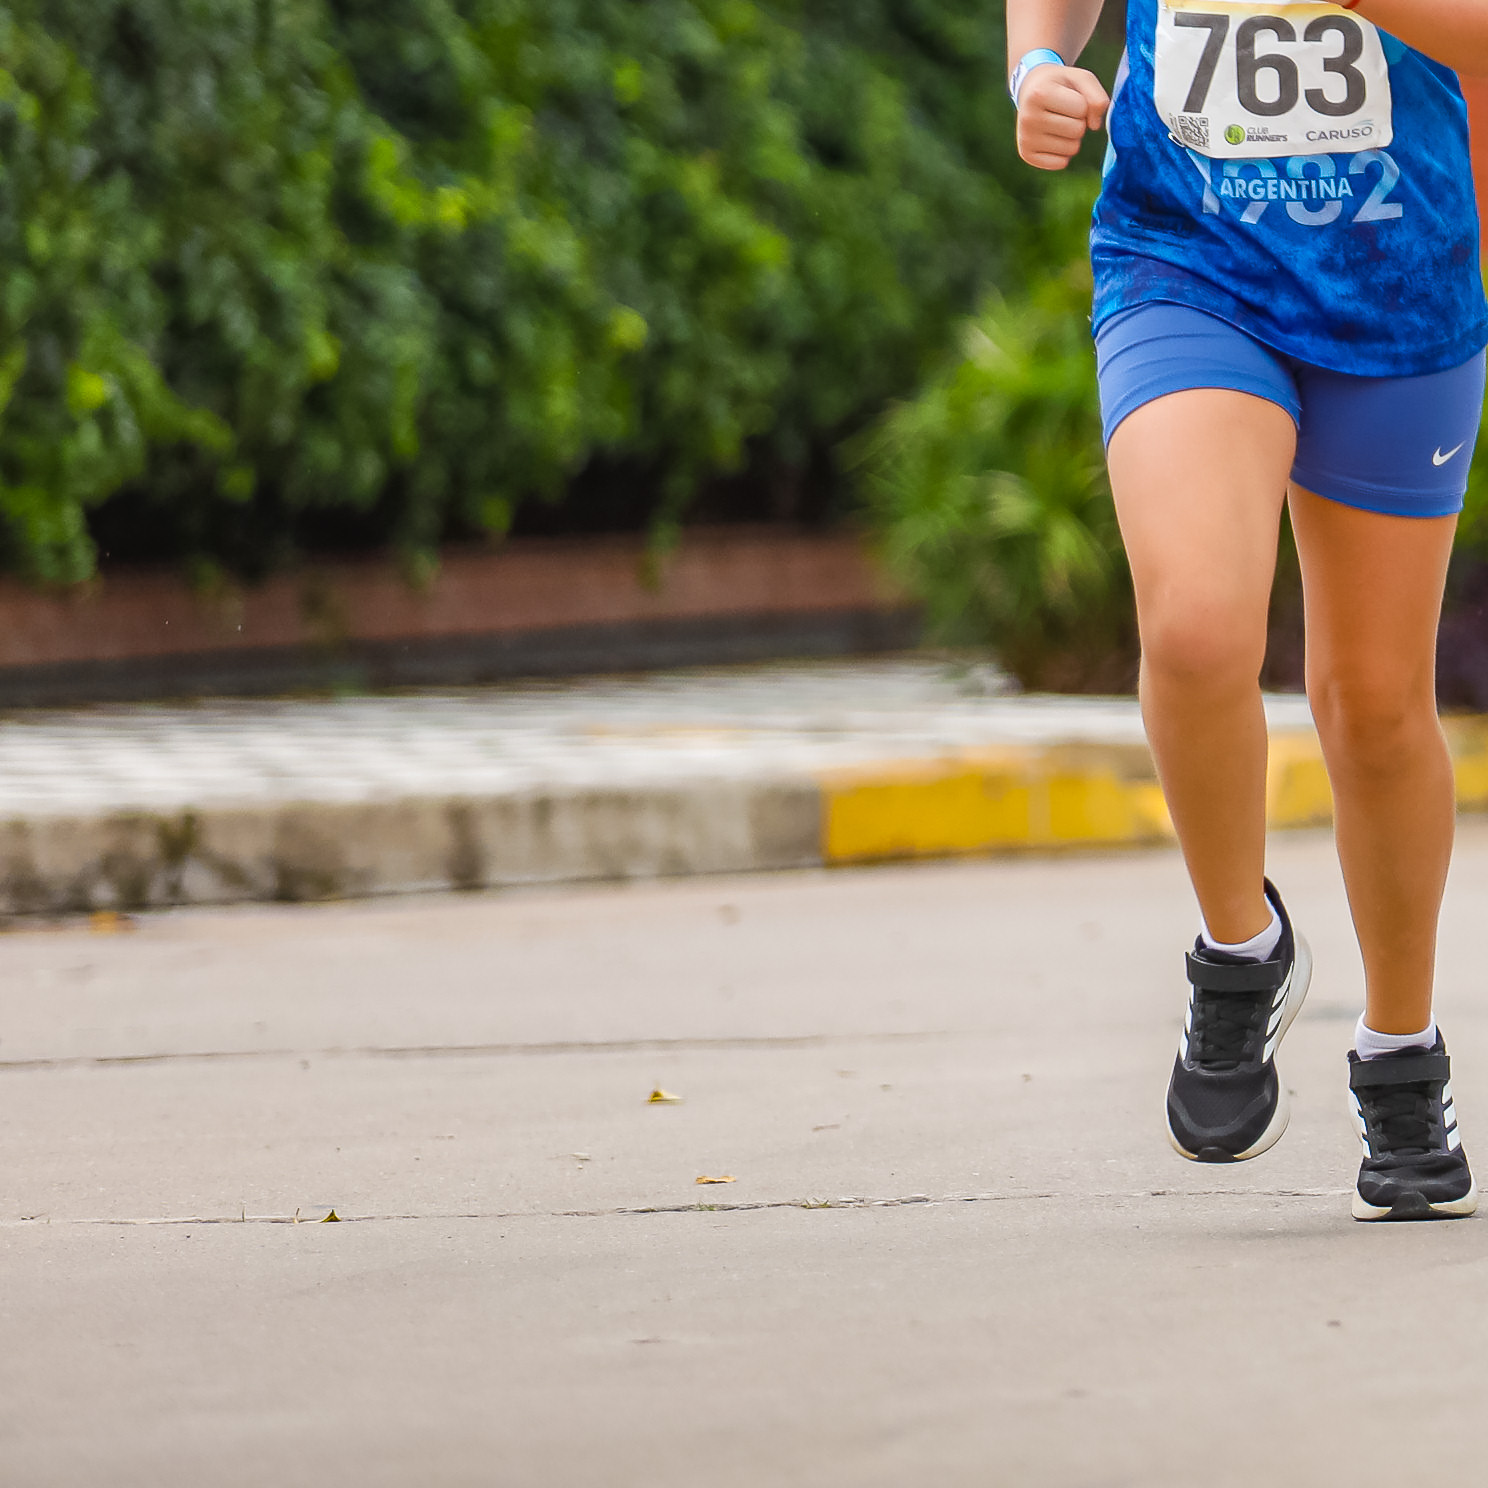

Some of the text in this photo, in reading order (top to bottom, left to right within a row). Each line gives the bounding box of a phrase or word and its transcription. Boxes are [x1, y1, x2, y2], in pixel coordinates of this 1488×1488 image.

[1174, 12, 1366, 117] 763
[1306, 125, 1373, 141] CARUSO
[1220, 177, 1354, 199] ARGENTINA
